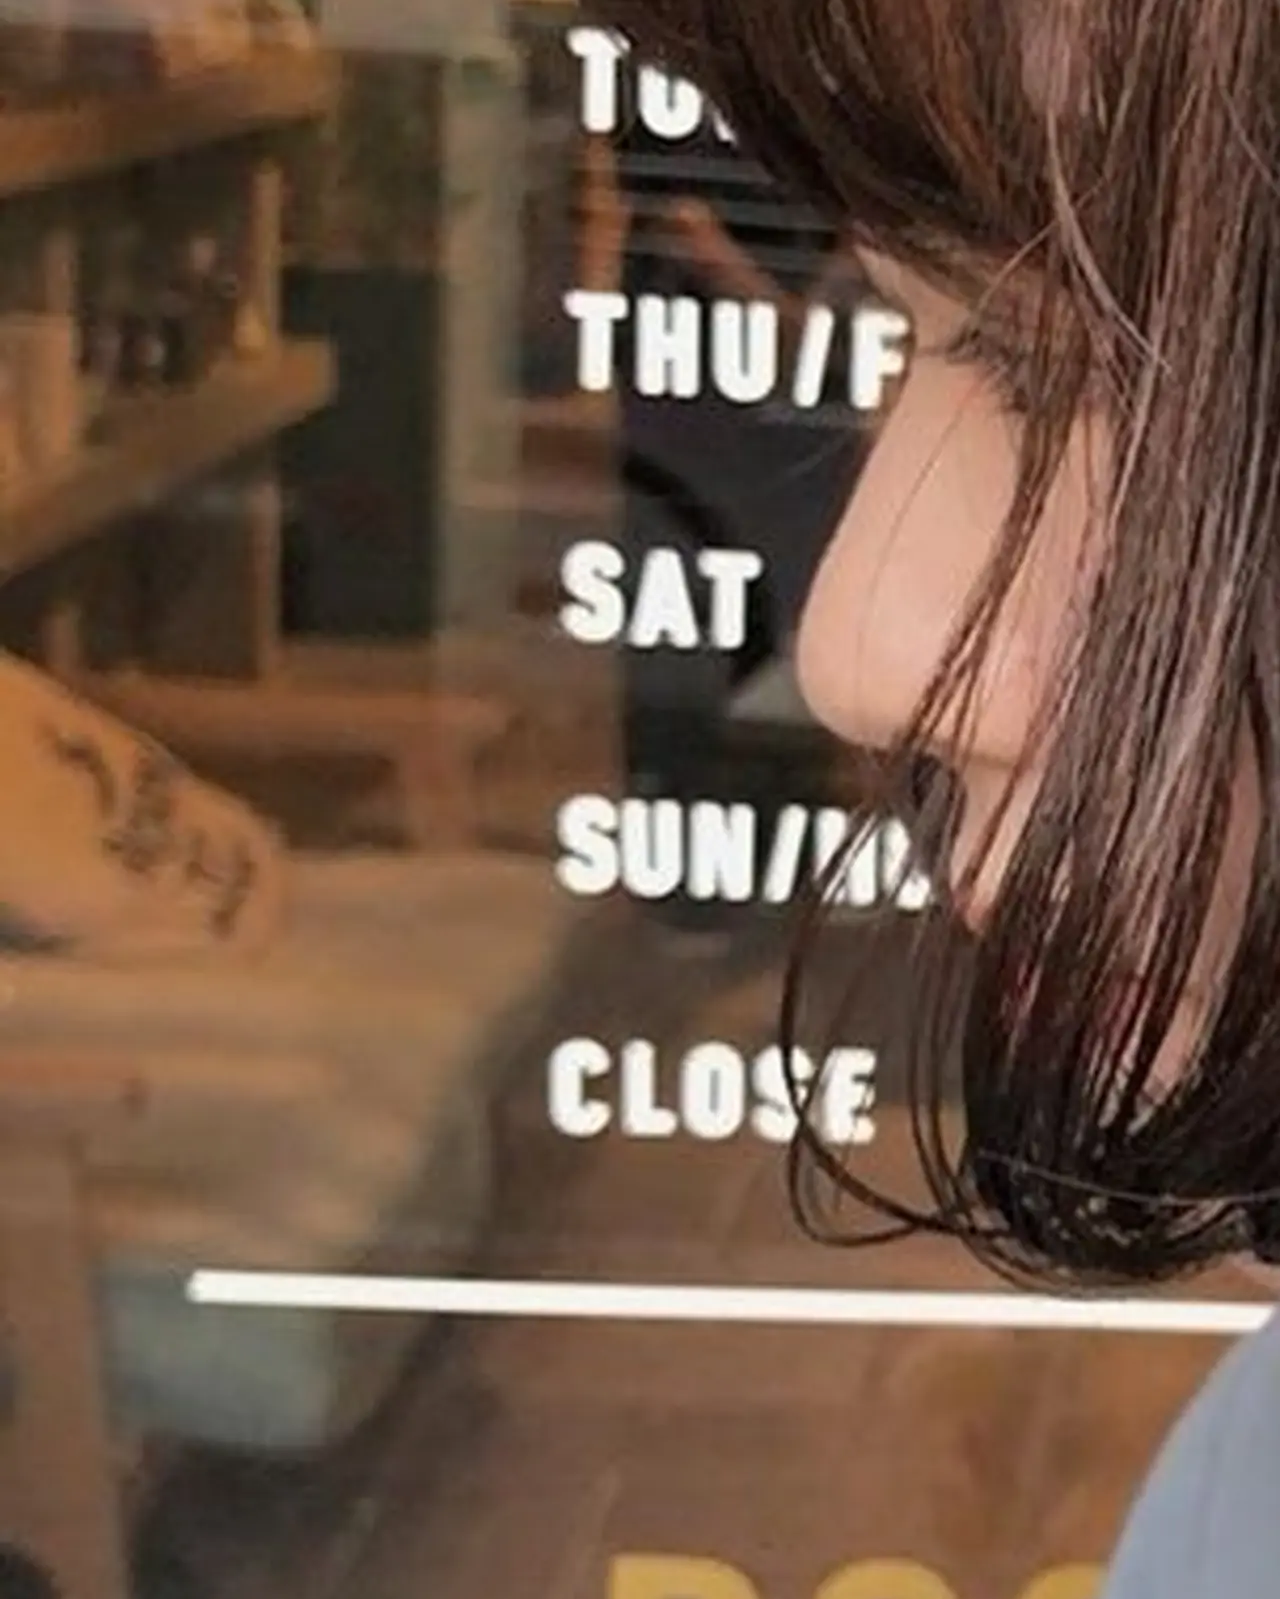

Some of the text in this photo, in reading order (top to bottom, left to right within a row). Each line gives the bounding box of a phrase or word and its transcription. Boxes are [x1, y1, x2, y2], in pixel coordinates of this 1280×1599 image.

[566, 25, 738, 143] TU
[559, 540, 763, 650] SAT
[547, 1037, 878, 1145] CLOSE
